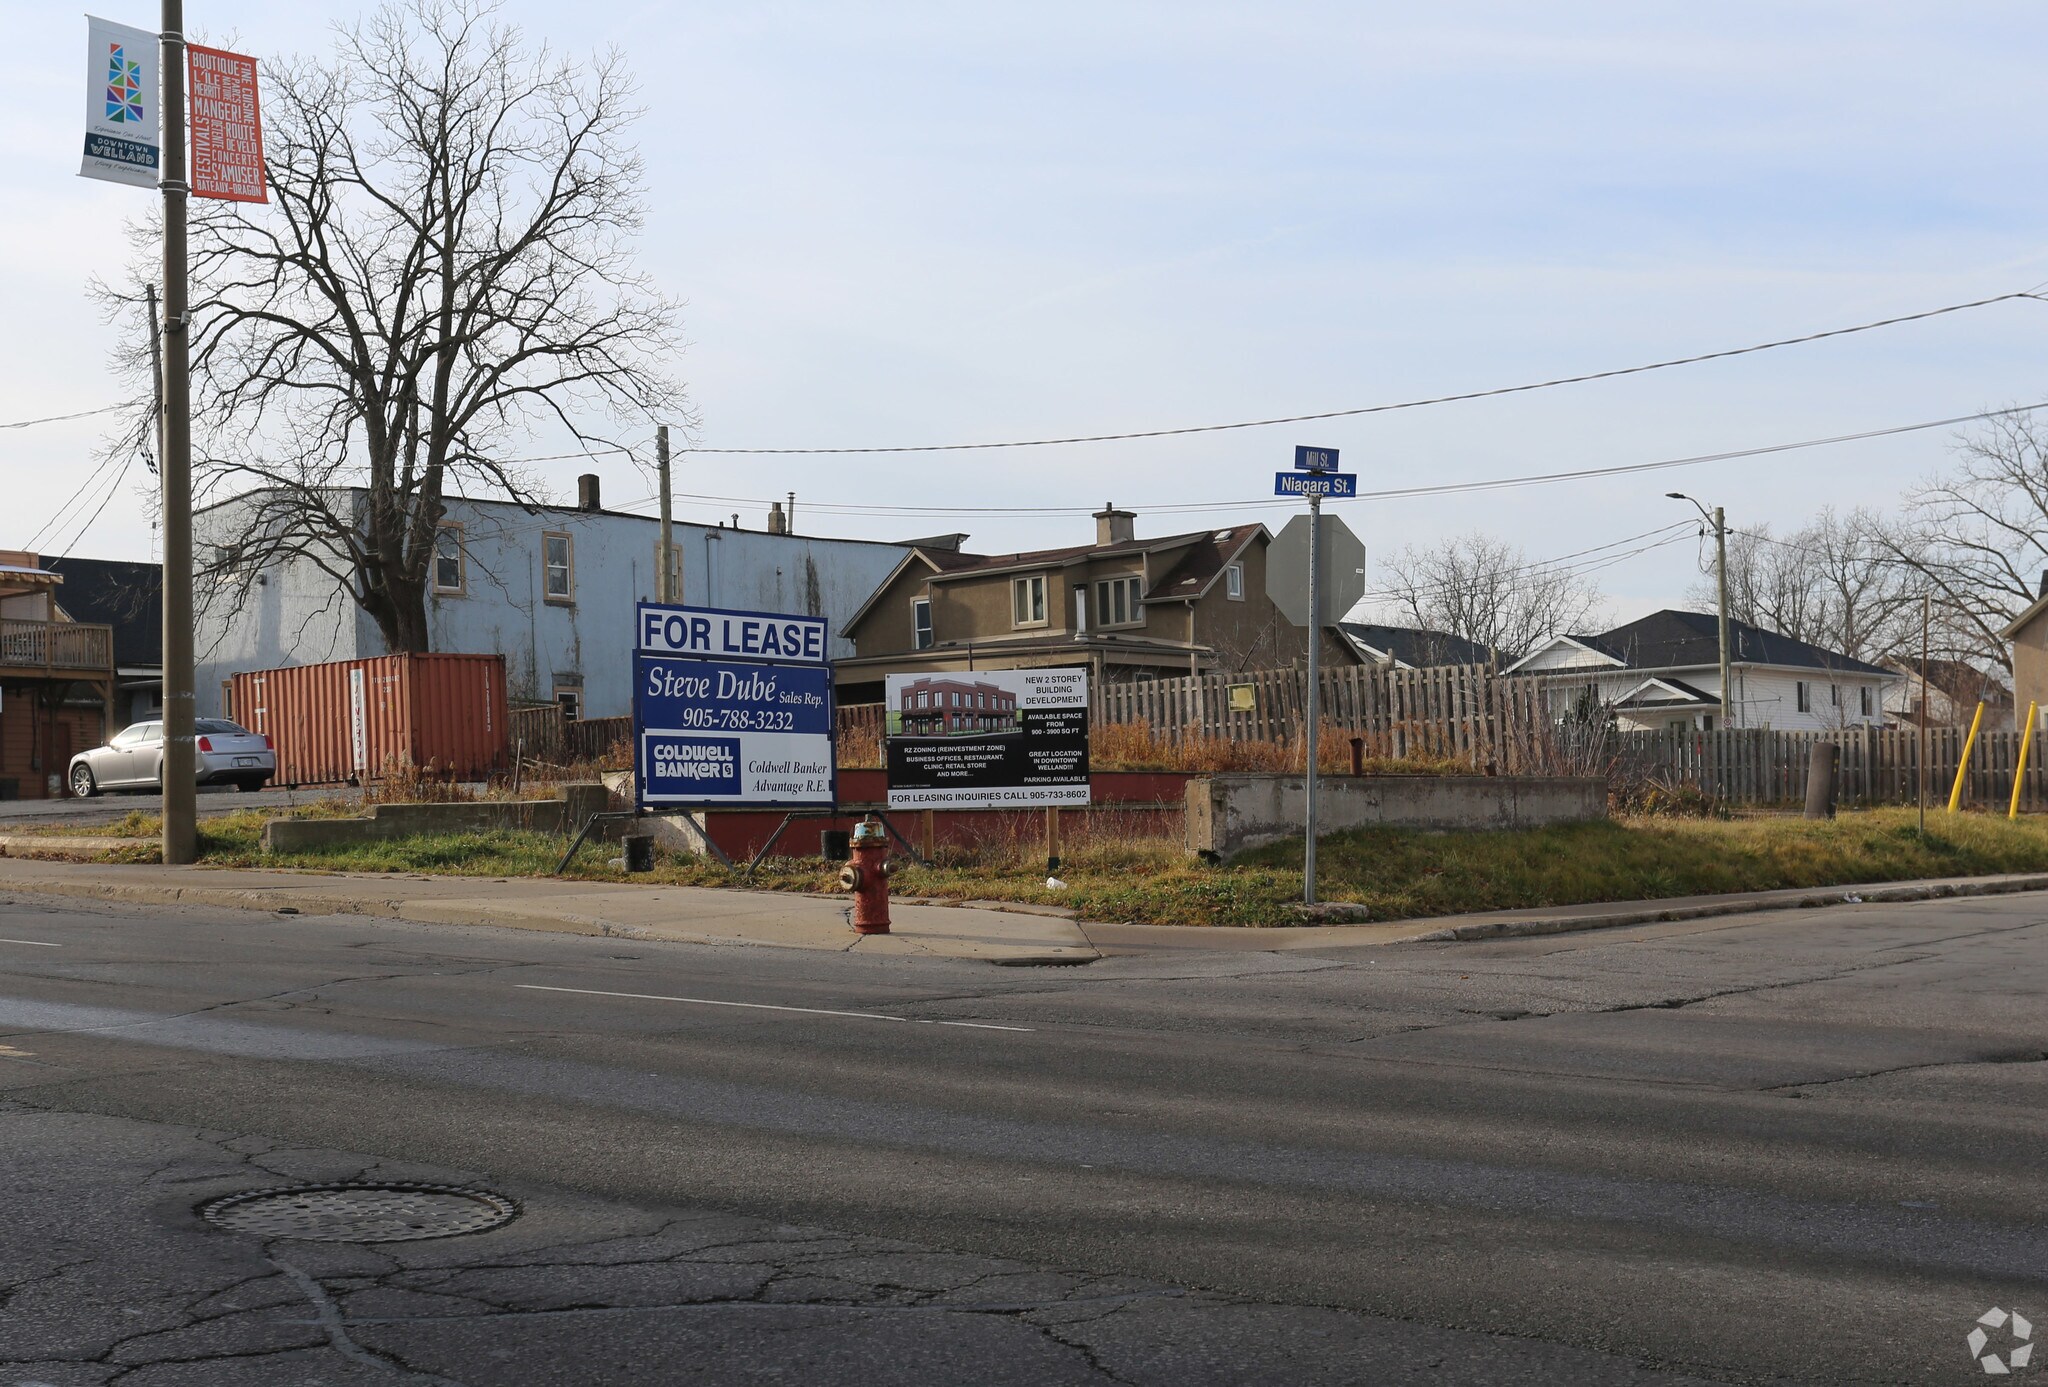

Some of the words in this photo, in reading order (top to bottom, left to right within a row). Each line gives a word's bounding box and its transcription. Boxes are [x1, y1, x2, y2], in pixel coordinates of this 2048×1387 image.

[193, 52, 240, 76] BOUTIQUE
[241, 62, 252, 85] FINE
[222, 76, 232, 102] NATURE
[232, 78, 241, 104] PARCS
[194, 96, 242, 123] MANGER!
[242, 88, 255, 125] CUISINE
[225, 122, 256, 141] ROUTE
[91, 144, 154, 165] WELLAND
[98, 138, 148, 153] DOWNTOWN
[195, 116, 211, 180] FESTIVALS
[226, 139, 236, 152] DE
[212, 150, 258, 167] CONCERTS
[212, 162, 260, 185] S'AMUSER
[197, 179, 262, 197] BATEAUX-DRAGON
[1306, 451, 1319, 466] Mill
[1320, 452, 1329, 467] St.
[1281, 476, 1330, 493] Niagara
[1334, 478, 1351, 493] St.
[644, 613, 712, 651] FOR
[723, 619, 821, 658] LEASE
[648, 666, 710, 699] Steve
[716, 670, 777, 702] Dubé
[779, 691, 802, 705] Sales
[804, 692, 824, 708] Rep.
[1052, 675, 1082, 683] STOREY
[1036, 686, 1072, 694] BUILDING
[1026, 696, 1083, 704] DEVELOPMENT
[682, 708, 794, 731] 905-788-3232
[937, 745, 985, 753] (REINVESTMENT
[748, 760, 791, 774] Coldwell
[792, 761, 827, 775] Banker
[753, 780, 803, 795] Advantage
[806, 780, 826, 793] R.E.
[892, 795, 911, 803] FOR
[913, 793, 953, 802] LEASING
[955, 792, 1001, 801] INQUIRIES
[1003, 791, 1027, 800] CALL
[1030, 790, 1087, 799] 905-733-8602
